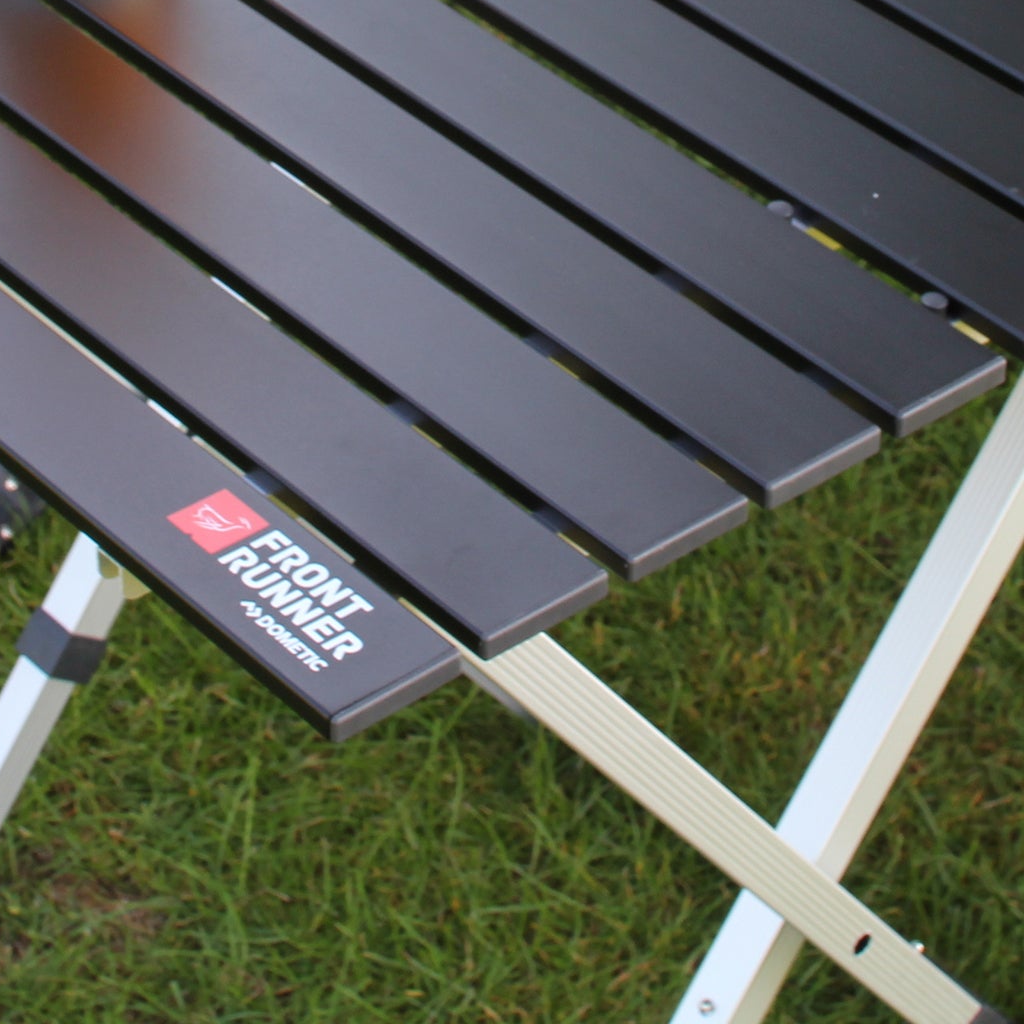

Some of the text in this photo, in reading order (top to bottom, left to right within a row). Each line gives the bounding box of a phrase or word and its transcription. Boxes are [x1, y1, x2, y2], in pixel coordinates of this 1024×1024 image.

[217, 545, 364, 661] RUNNER
[249, 529, 374, 619] FRONT
[254, 614, 329, 672] DOMETIC
